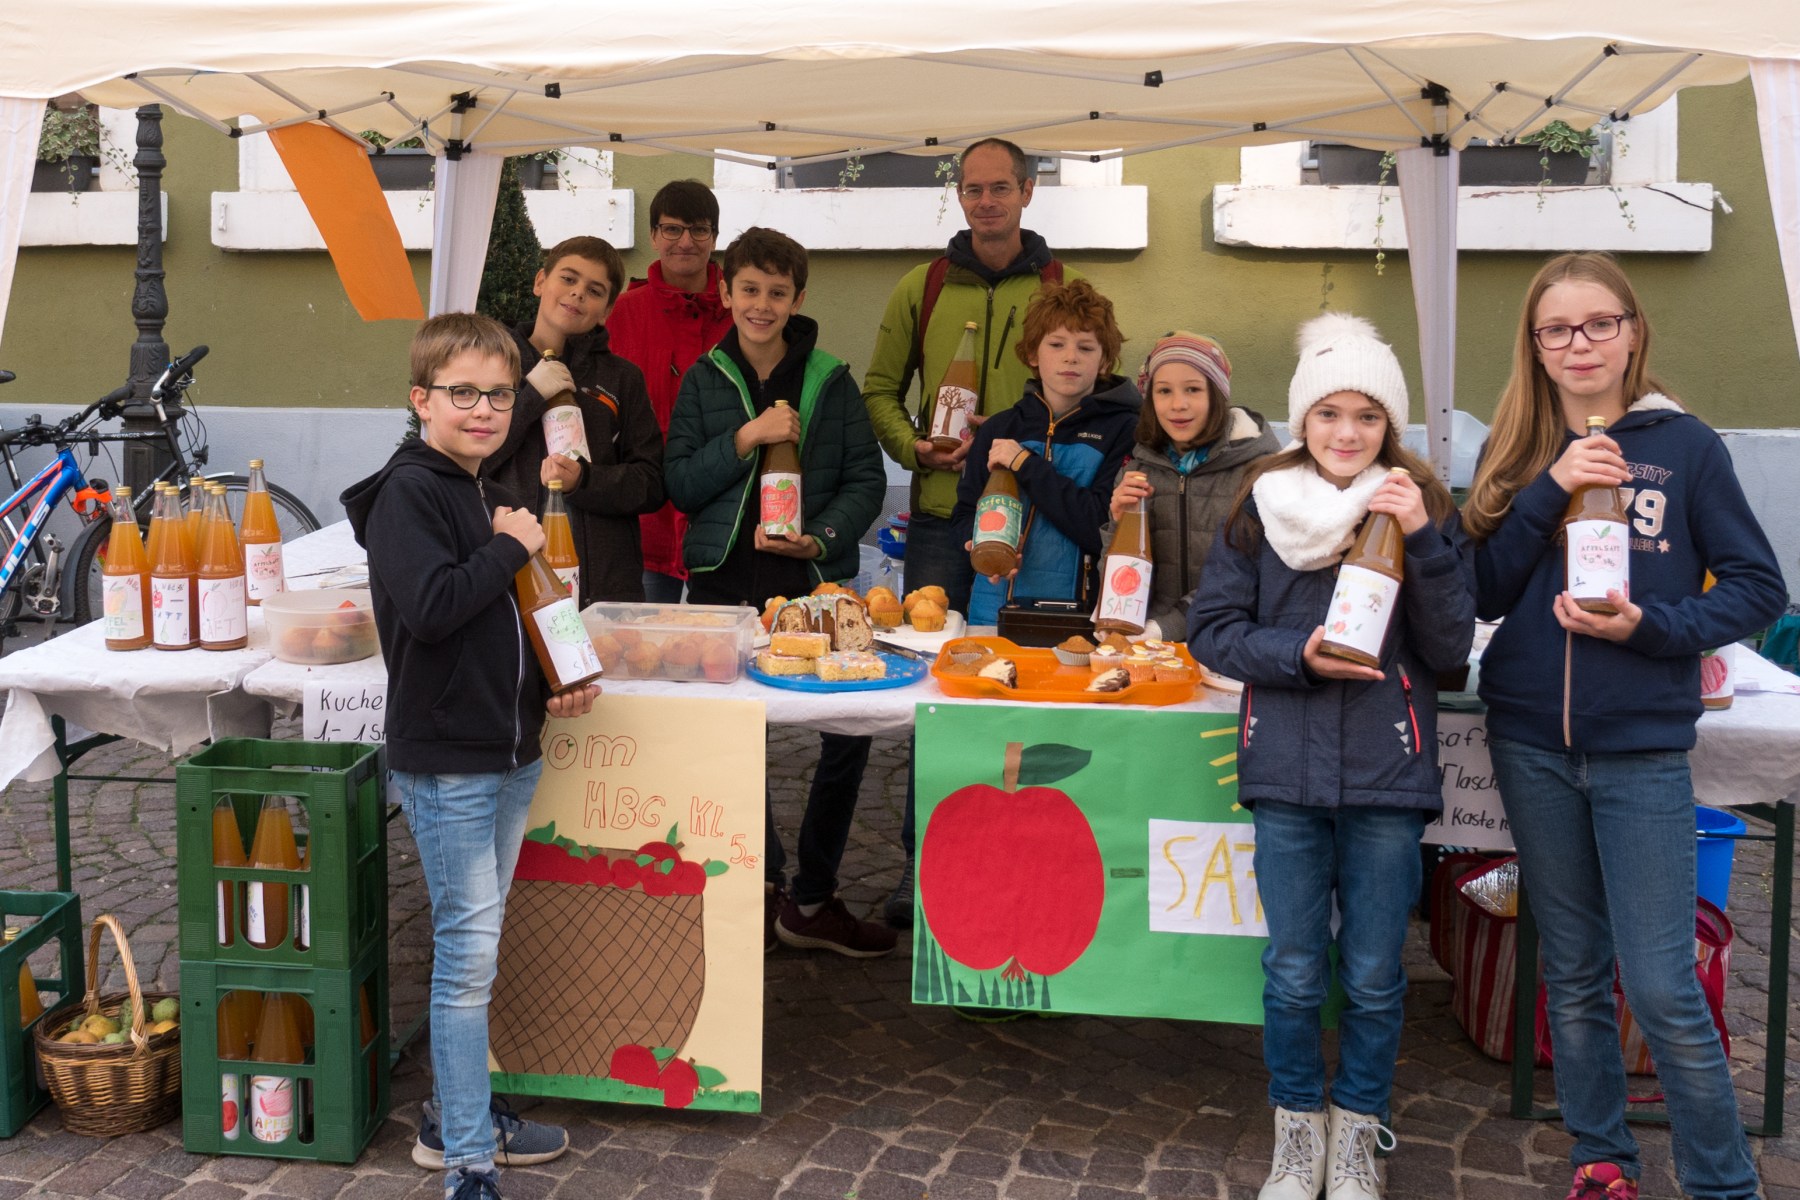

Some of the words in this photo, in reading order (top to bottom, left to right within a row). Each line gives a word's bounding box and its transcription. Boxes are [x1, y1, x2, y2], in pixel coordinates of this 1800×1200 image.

[1624, 462, 1673, 485] RSITY
[1105, 597, 1144, 617] SAFT
[321, 688, 384, 712] Kuche
[540, 720, 637, 770] om
[583, 780, 667, 830] HBG
